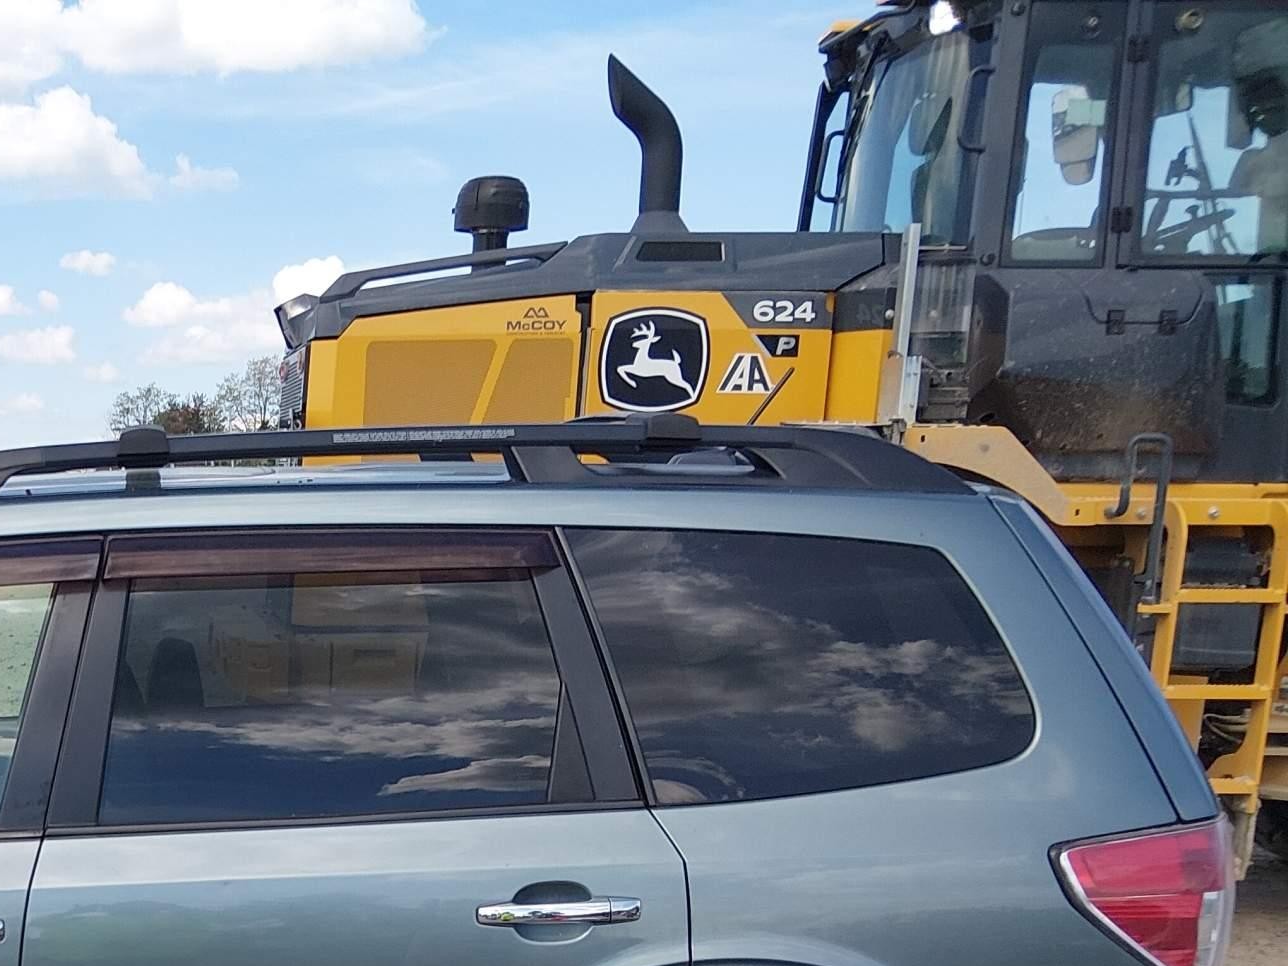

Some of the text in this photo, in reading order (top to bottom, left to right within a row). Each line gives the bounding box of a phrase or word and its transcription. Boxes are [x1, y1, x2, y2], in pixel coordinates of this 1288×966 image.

[753, 300, 816, 322] 624
[506, 319, 568, 331] McCOY
[775, 336, 796, 356] P
